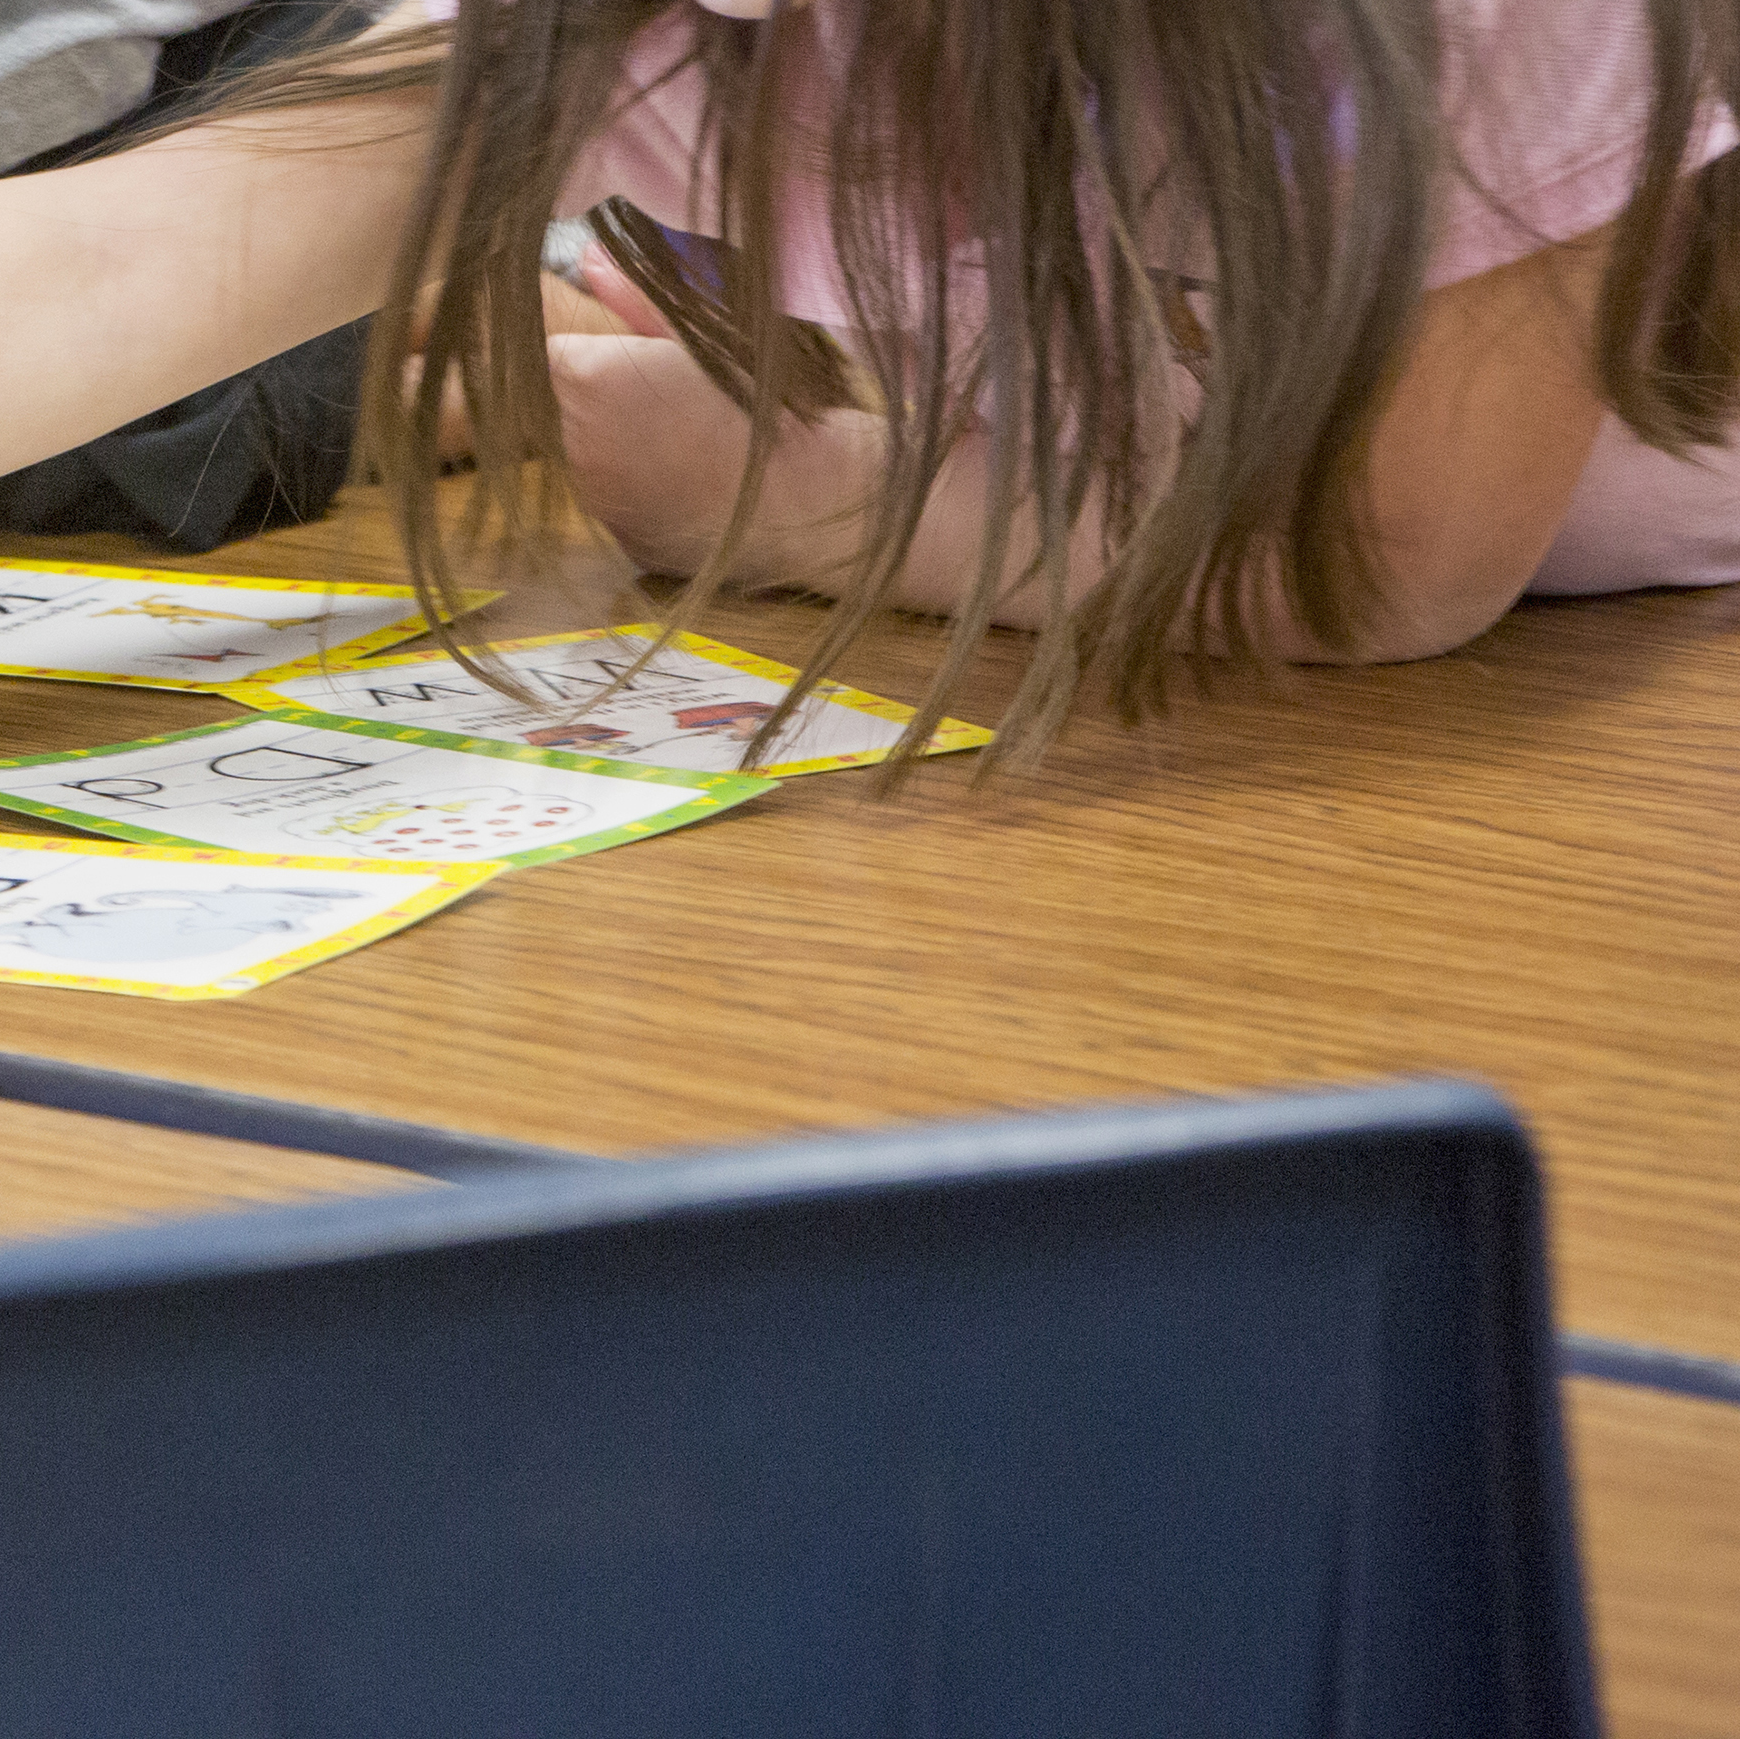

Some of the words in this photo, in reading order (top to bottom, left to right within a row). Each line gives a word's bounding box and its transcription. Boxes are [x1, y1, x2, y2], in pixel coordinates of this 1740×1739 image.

[367, 683, 477, 706] w
[527, 660, 703, 699] W
[211, 747, 373, 781] D
[59, 779, 172, 809] d
[278, 780, 401, 808] Doughnuts
